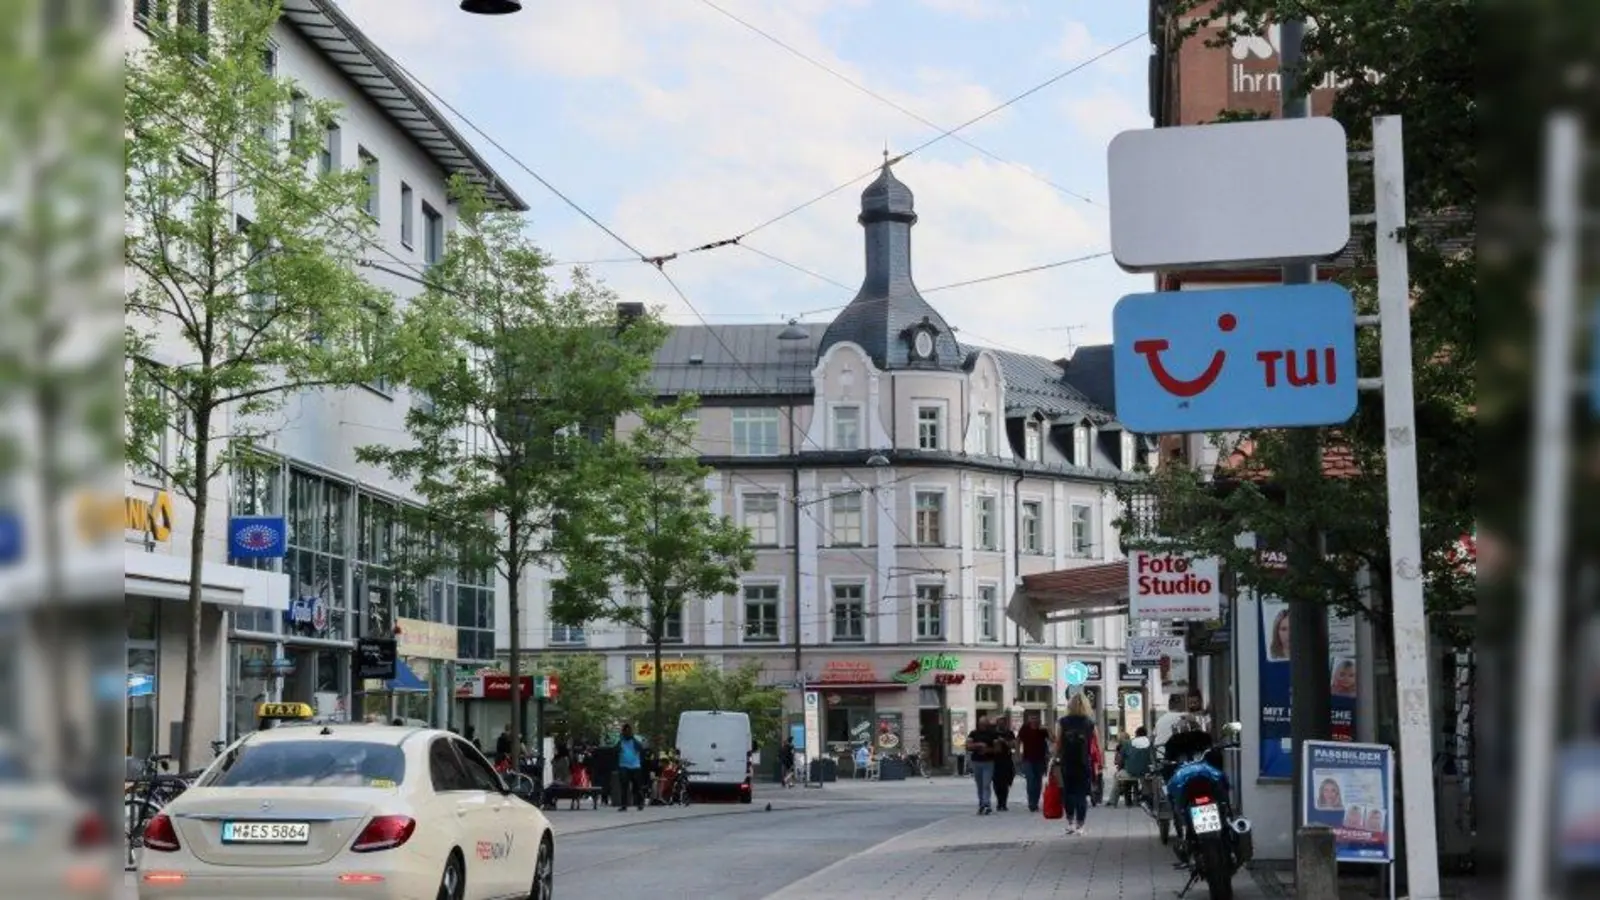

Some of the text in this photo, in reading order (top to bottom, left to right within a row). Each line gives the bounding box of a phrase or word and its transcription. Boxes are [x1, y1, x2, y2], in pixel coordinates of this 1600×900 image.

[1232, 63, 1264, 93] Ihr
[1256, 348, 1337, 388] TUI
[1138, 554, 1188, 574] Foto
[1138, 573, 1212, 596] Studio
[266, 705, 301, 715] TAXI
[1314, 748, 1382, 761] PASSBILDER
[271, 825, 305, 838] 5864
